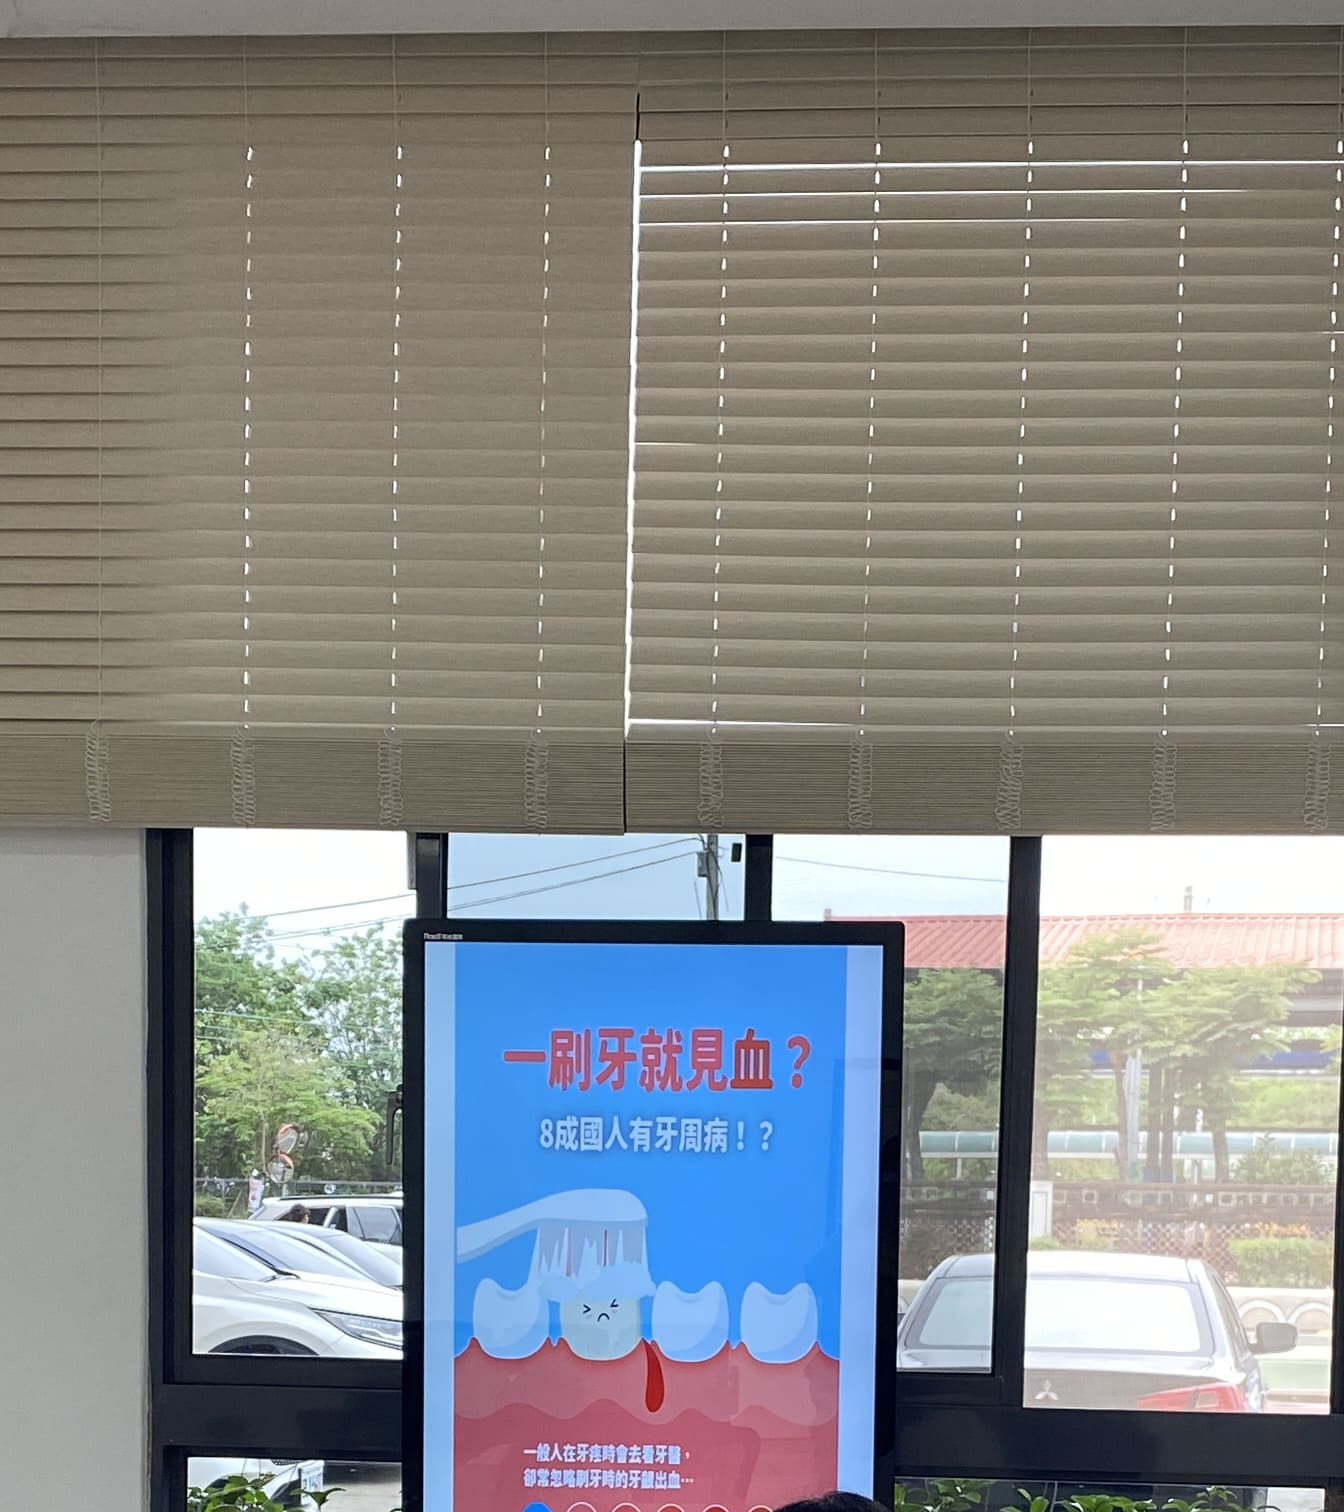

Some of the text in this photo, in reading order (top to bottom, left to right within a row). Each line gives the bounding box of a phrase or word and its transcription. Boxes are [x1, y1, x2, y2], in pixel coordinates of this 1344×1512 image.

[503, 1028, 811, 1092] 一刷牙就見血？
[540, 1116, 774, 1153] 8成國人有牙周病！？
